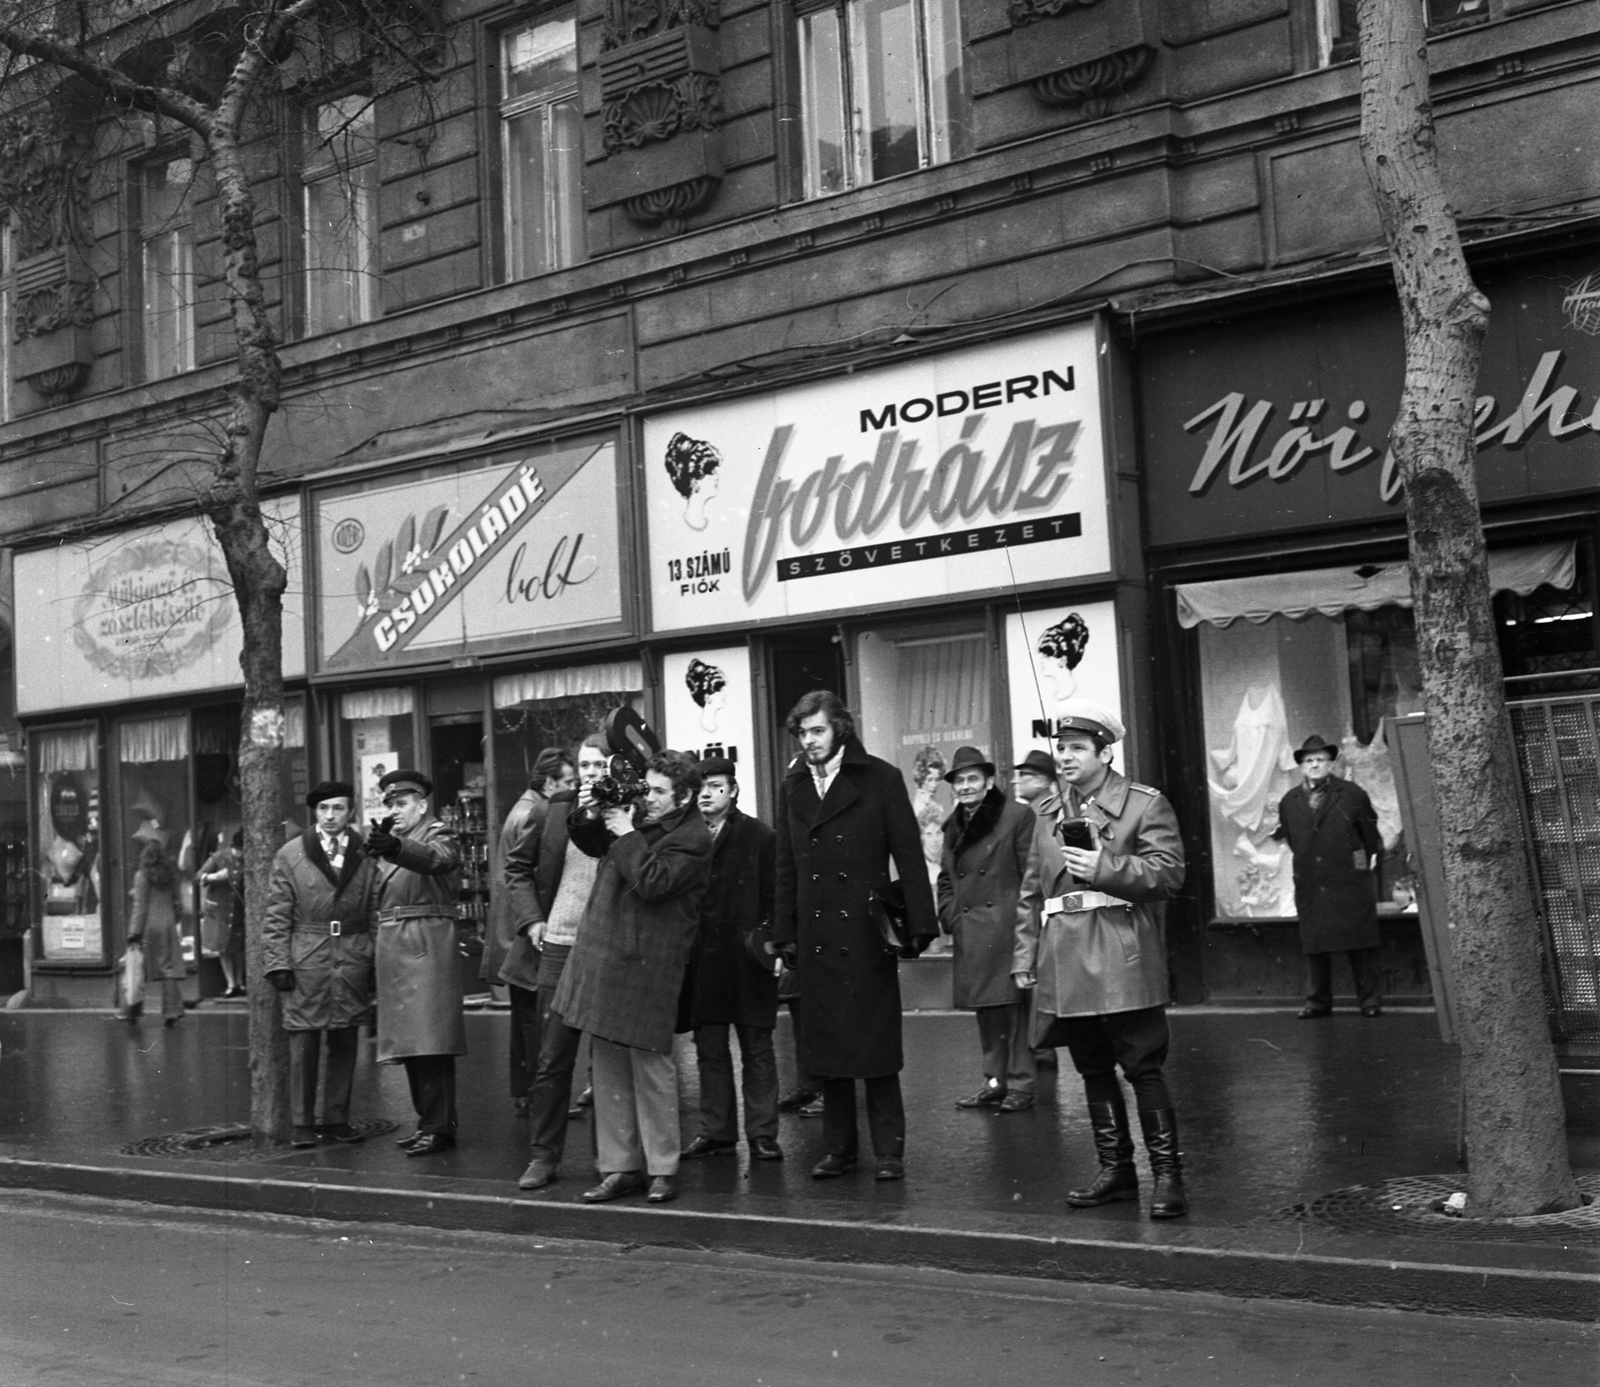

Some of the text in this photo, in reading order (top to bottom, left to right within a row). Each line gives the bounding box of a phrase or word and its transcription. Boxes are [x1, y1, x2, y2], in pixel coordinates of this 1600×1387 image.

[1562, 275, 1600, 330] Ara
[859, 365, 1076, 433] MODERN
[741, 412, 1084, 607] fodrász
[373, 465, 545, 652] CSOKOLÁDÉ
[499, 532, 599, 604] bolt
[667, 546, 731, 582] 13 SZÁMÚ
[788, 519, 1065, 576] SZÖVETKEZET
[680, 578, 720, 597] FIÓK
